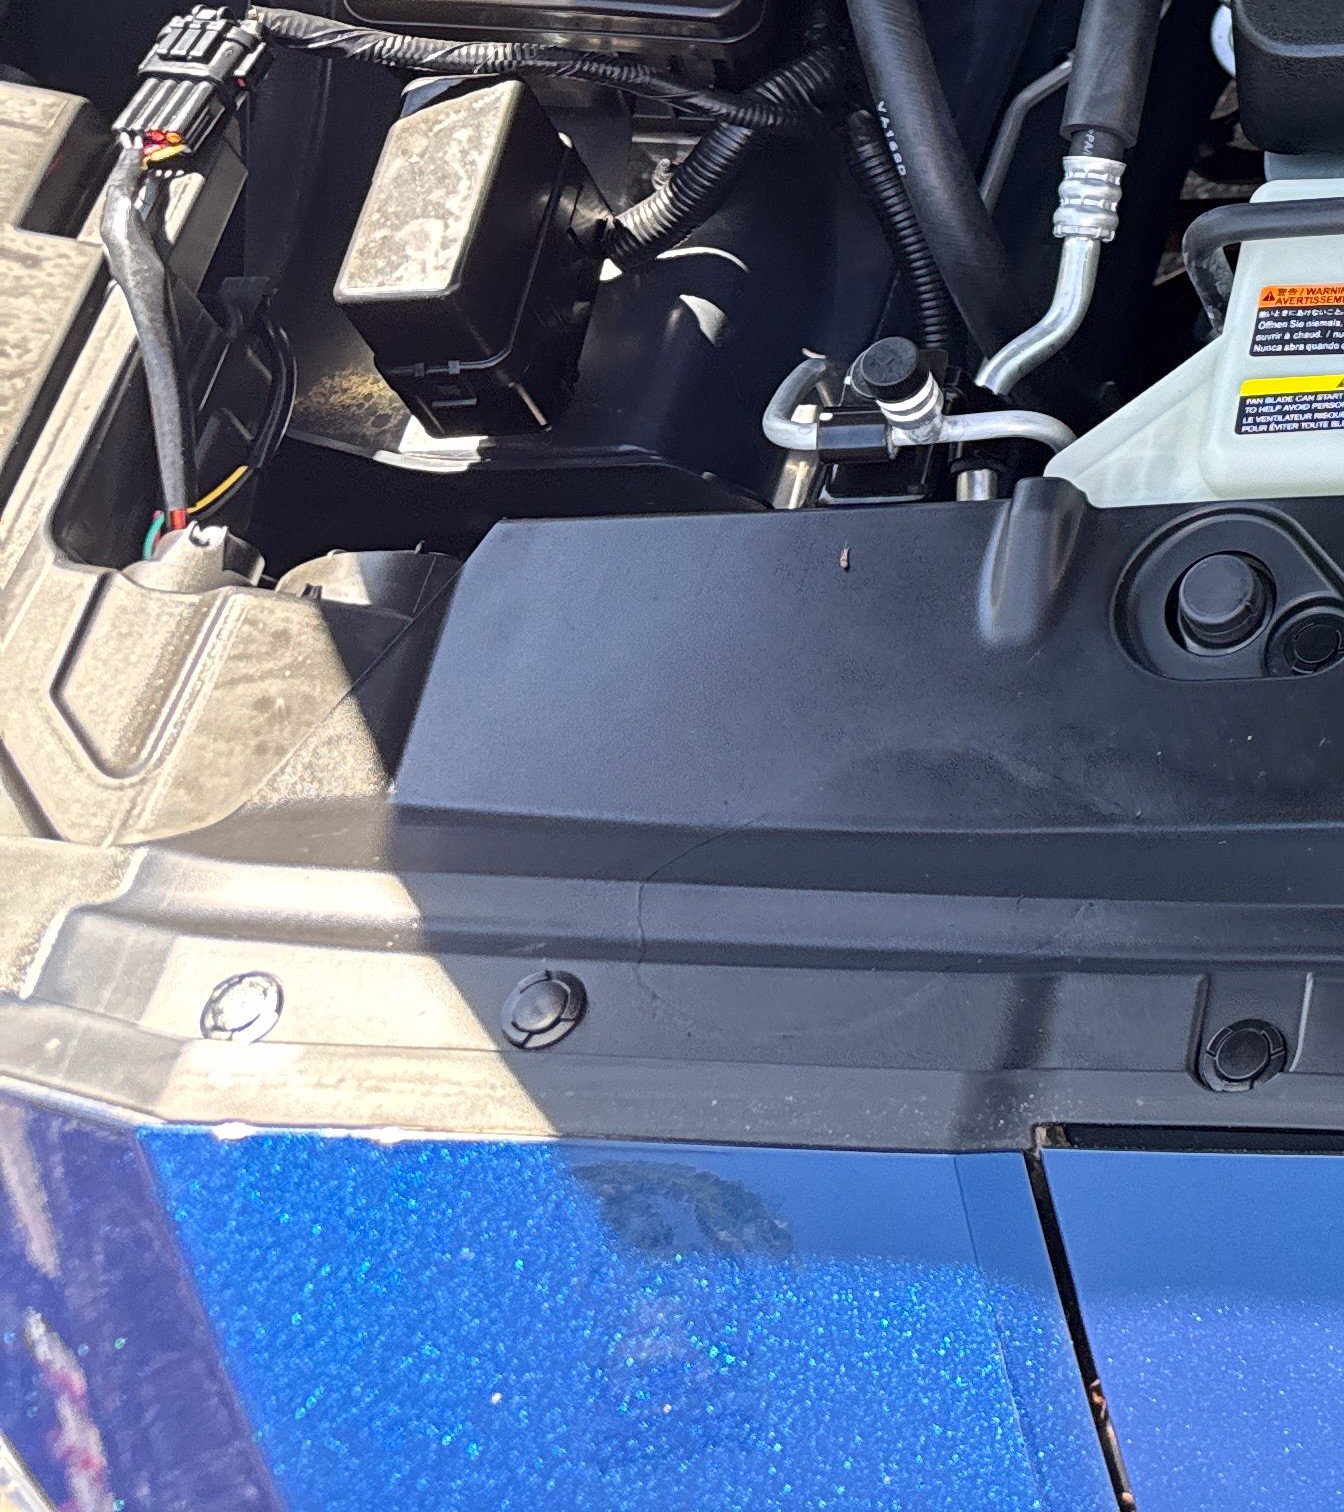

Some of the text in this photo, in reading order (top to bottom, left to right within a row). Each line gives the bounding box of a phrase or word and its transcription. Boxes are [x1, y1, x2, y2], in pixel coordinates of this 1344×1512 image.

[1253, 344, 1282, 352] Nunca
[1306, 342, 1339, 352] quando
[1264, 396, 1294, 404] BLADE
[1295, 394, 1315, 402] CAN
[1316, 393, 1344, 401] START
[1244, 406, 1257, 414] TO
[1258, 405, 1282, 413] HELP
[1282, 403, 1310, 412] AVOID
[1256, 413, 1313, 423] VENTILATEUR
[1241, 424, 1268, 433] POUR
[1300, 421, 1330, 429] TOUTE
